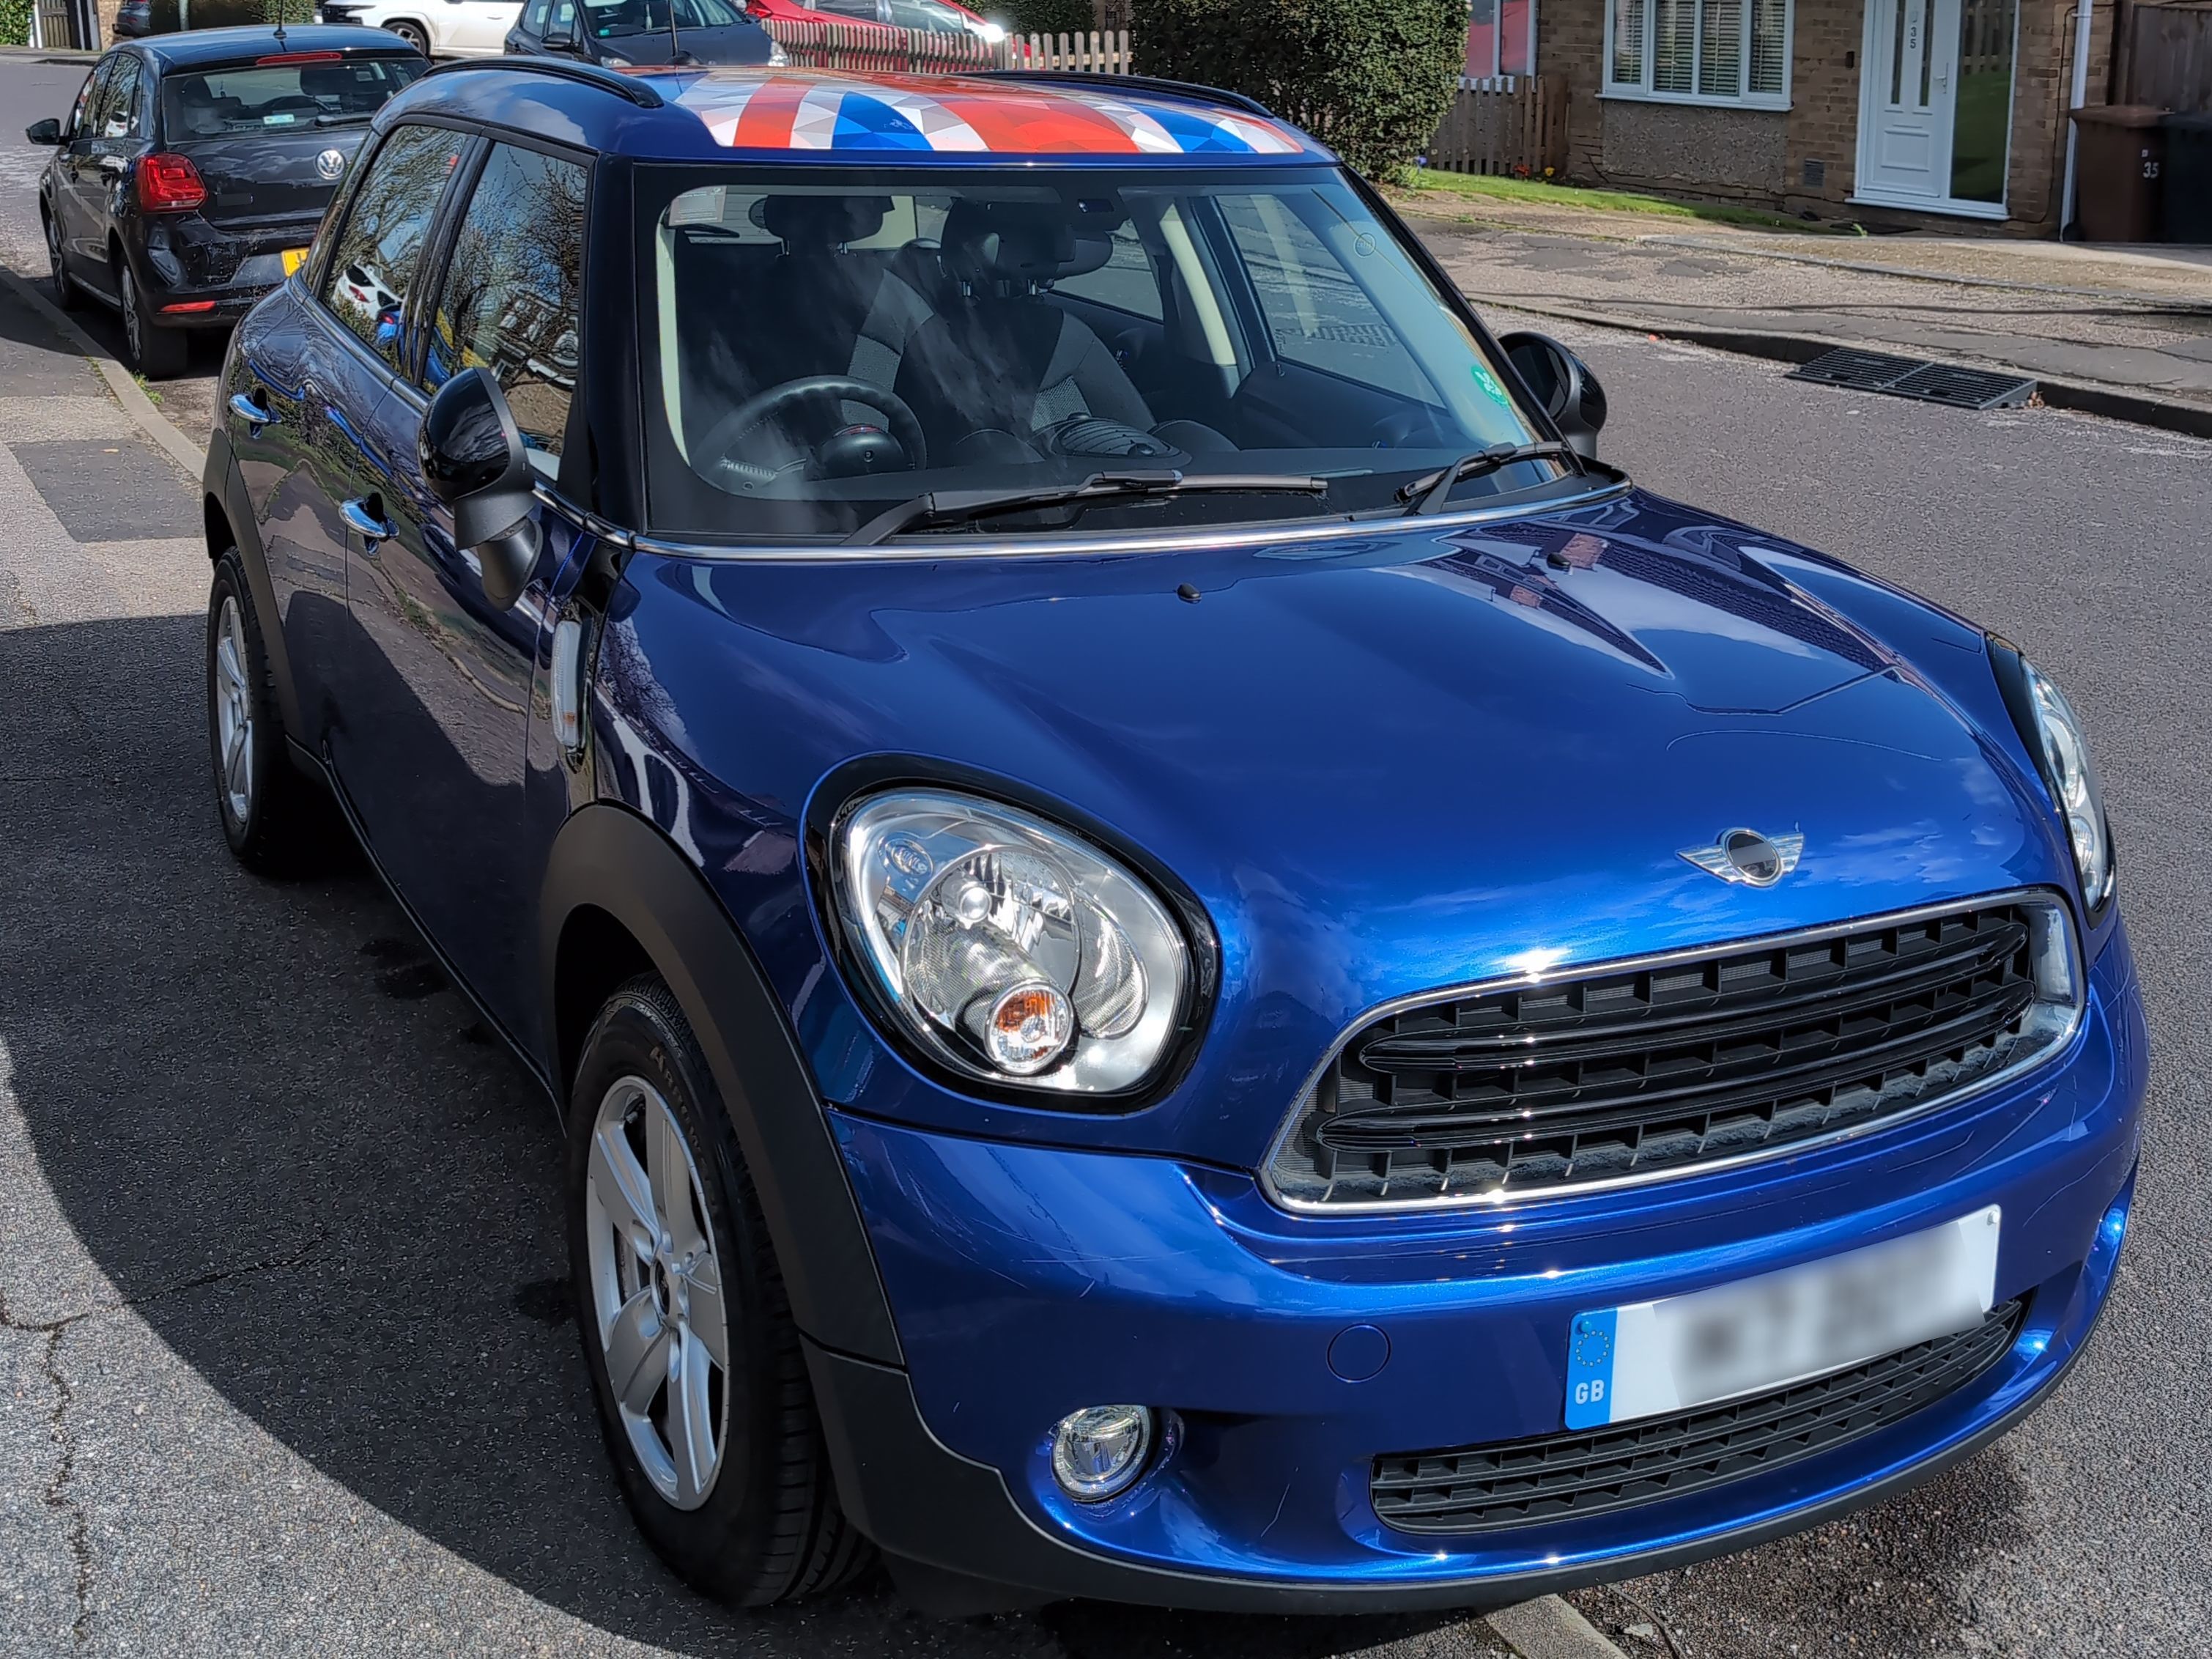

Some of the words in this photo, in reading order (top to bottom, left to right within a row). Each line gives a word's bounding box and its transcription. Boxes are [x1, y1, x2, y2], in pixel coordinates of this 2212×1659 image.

[1909, 26, 1917, 49] 35
[2142, 161, 2159, 179] 35
[1575, 1379, 1605, 1405] GB
